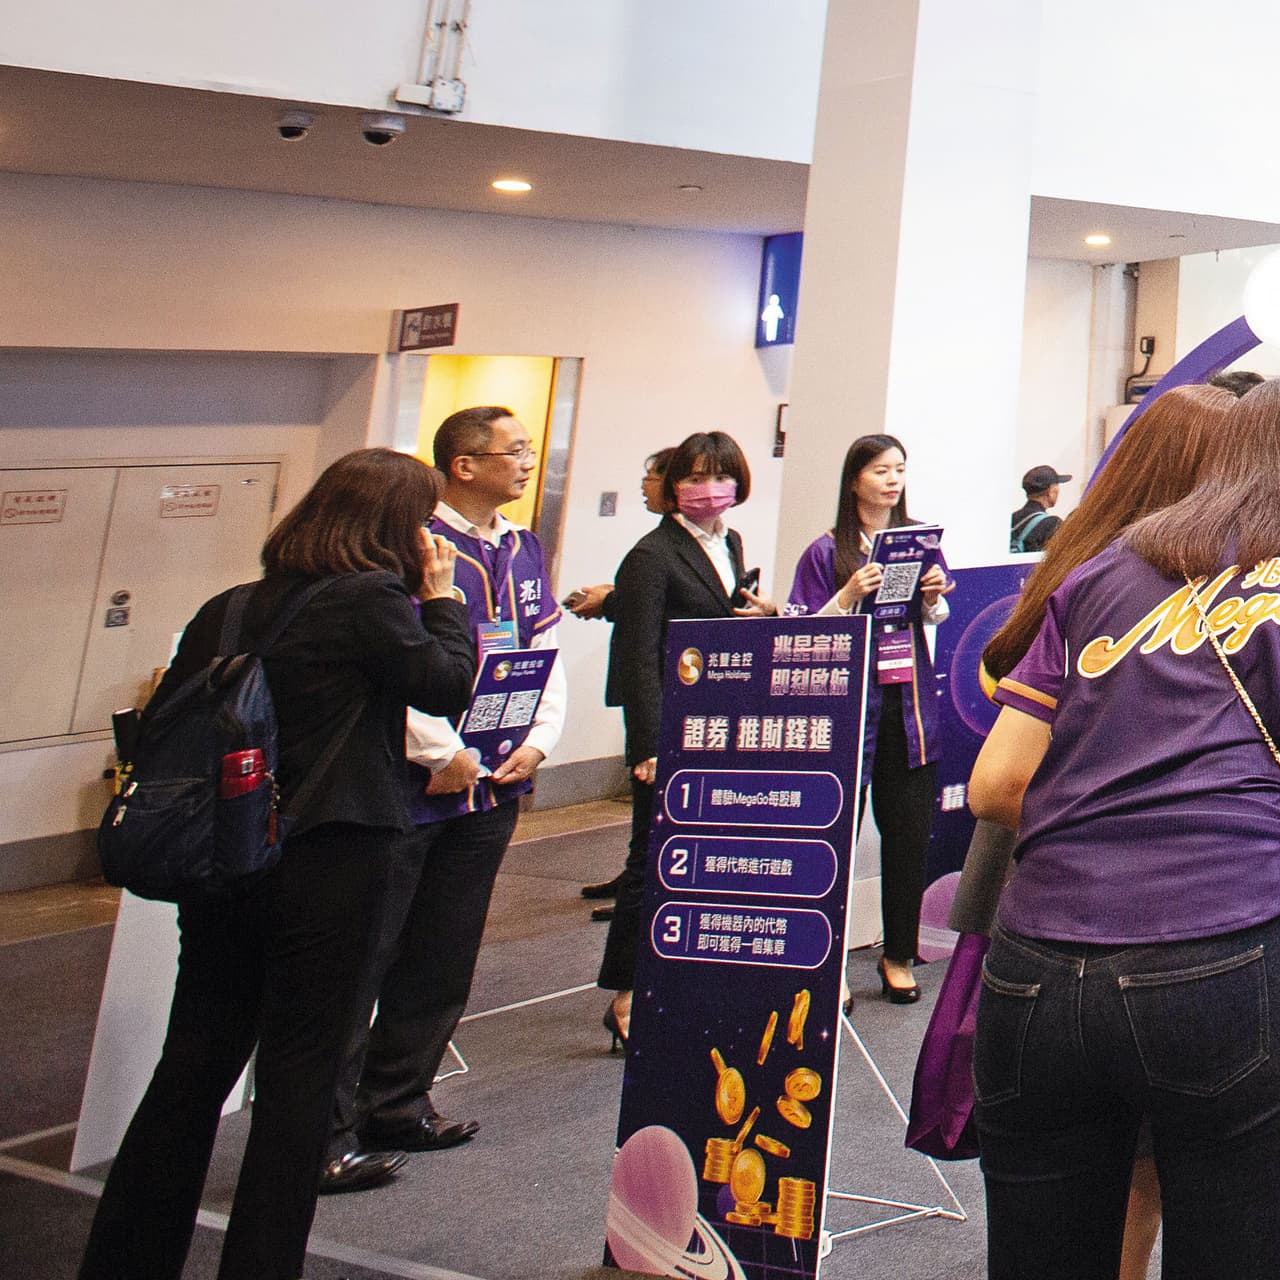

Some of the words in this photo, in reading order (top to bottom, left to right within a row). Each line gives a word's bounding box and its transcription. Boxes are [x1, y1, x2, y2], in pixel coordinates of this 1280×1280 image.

[708, 652, 753, 668] 兆豐金控
[707, 670, 724, 682] Mega
[682, 715, 729, 752] 證券
[736, 715, 833, 752] 推財錢進
[680, 782, 690, 809] 1
[669, 848, 689, 876] 2
[662, 915, 682, 943] 3
